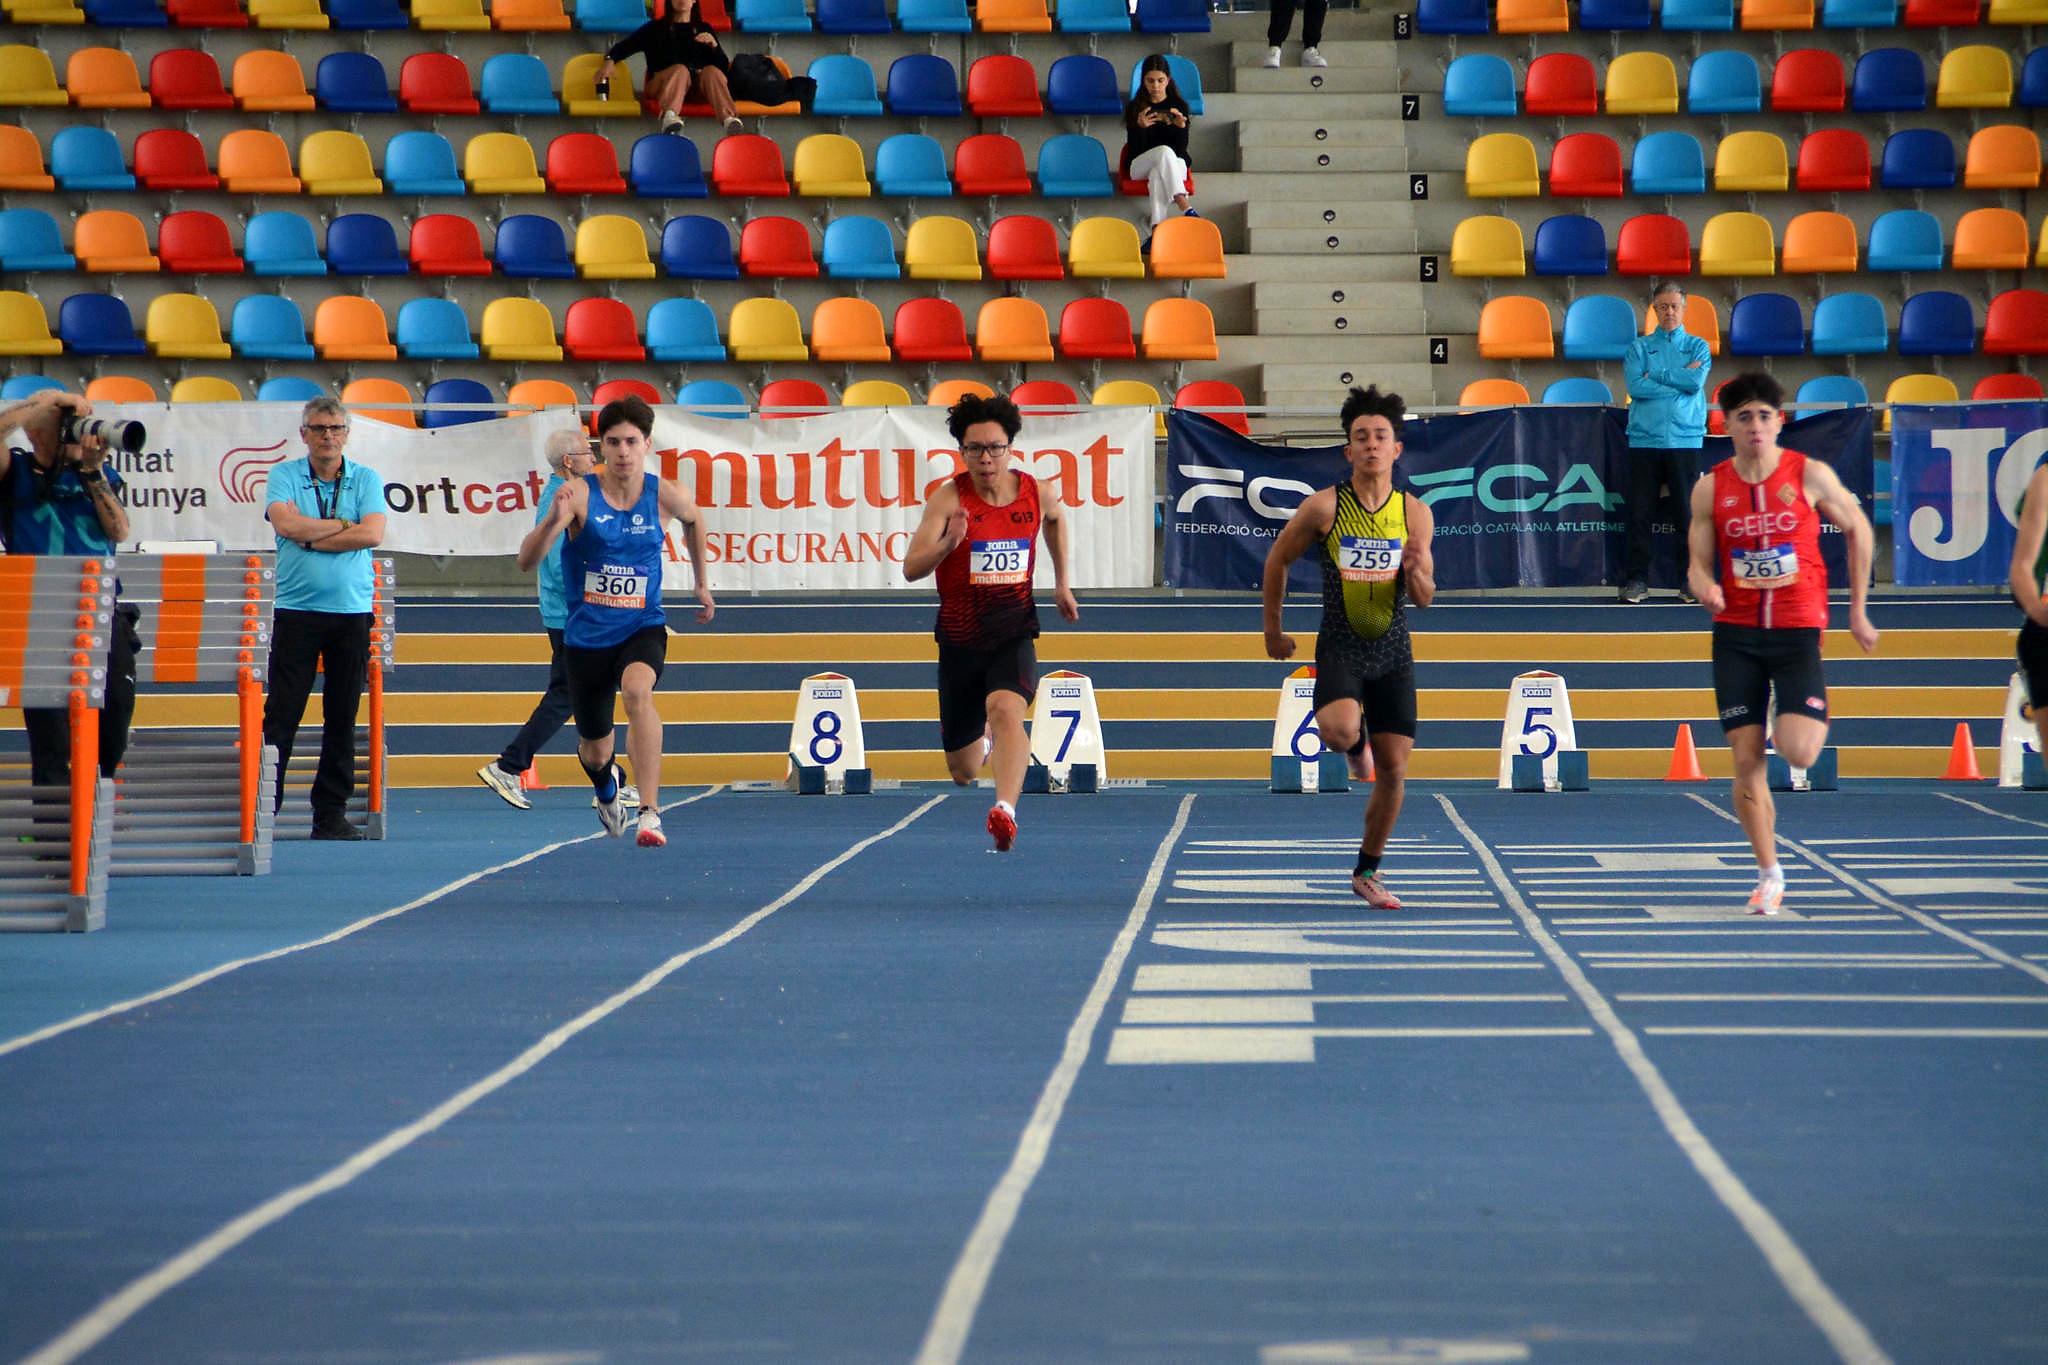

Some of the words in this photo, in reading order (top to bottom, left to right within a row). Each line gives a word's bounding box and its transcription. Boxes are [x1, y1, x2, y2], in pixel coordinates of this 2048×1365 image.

[1398, 20, 1407, 34] 8
[1406, 101, 1415, 115] 7
[1414, 180, 1424, 195] 6
[1425, 263, 1434, 276] 5
[1434, 344, 1444, 358] 4
[656, 435, 1124, 509] mutuaat
[384, 470, 544, 514] ortcat
[1408, 463, 1625, 513] FCA
[1175, 522, 1250, 536] FEDERACIÓ
[1485, 522, 1553, 534] CATALANA
[1556, 521, 1625, 532] ATLETISME
[660, 531, 917, 564] ASEGURANC
[982, 552, 1020, 571] 203
[1350, 550, 1391, 569] 259
[1744, 560, 1785, 577] 261
[596, 575, 636, 595] 360
[810, 711, 843, 764] 8
[1050, 710, 1081, 763] 7
[1291, 710, 1327, 762] 6
[1519, 707, 1557, 760] 5
